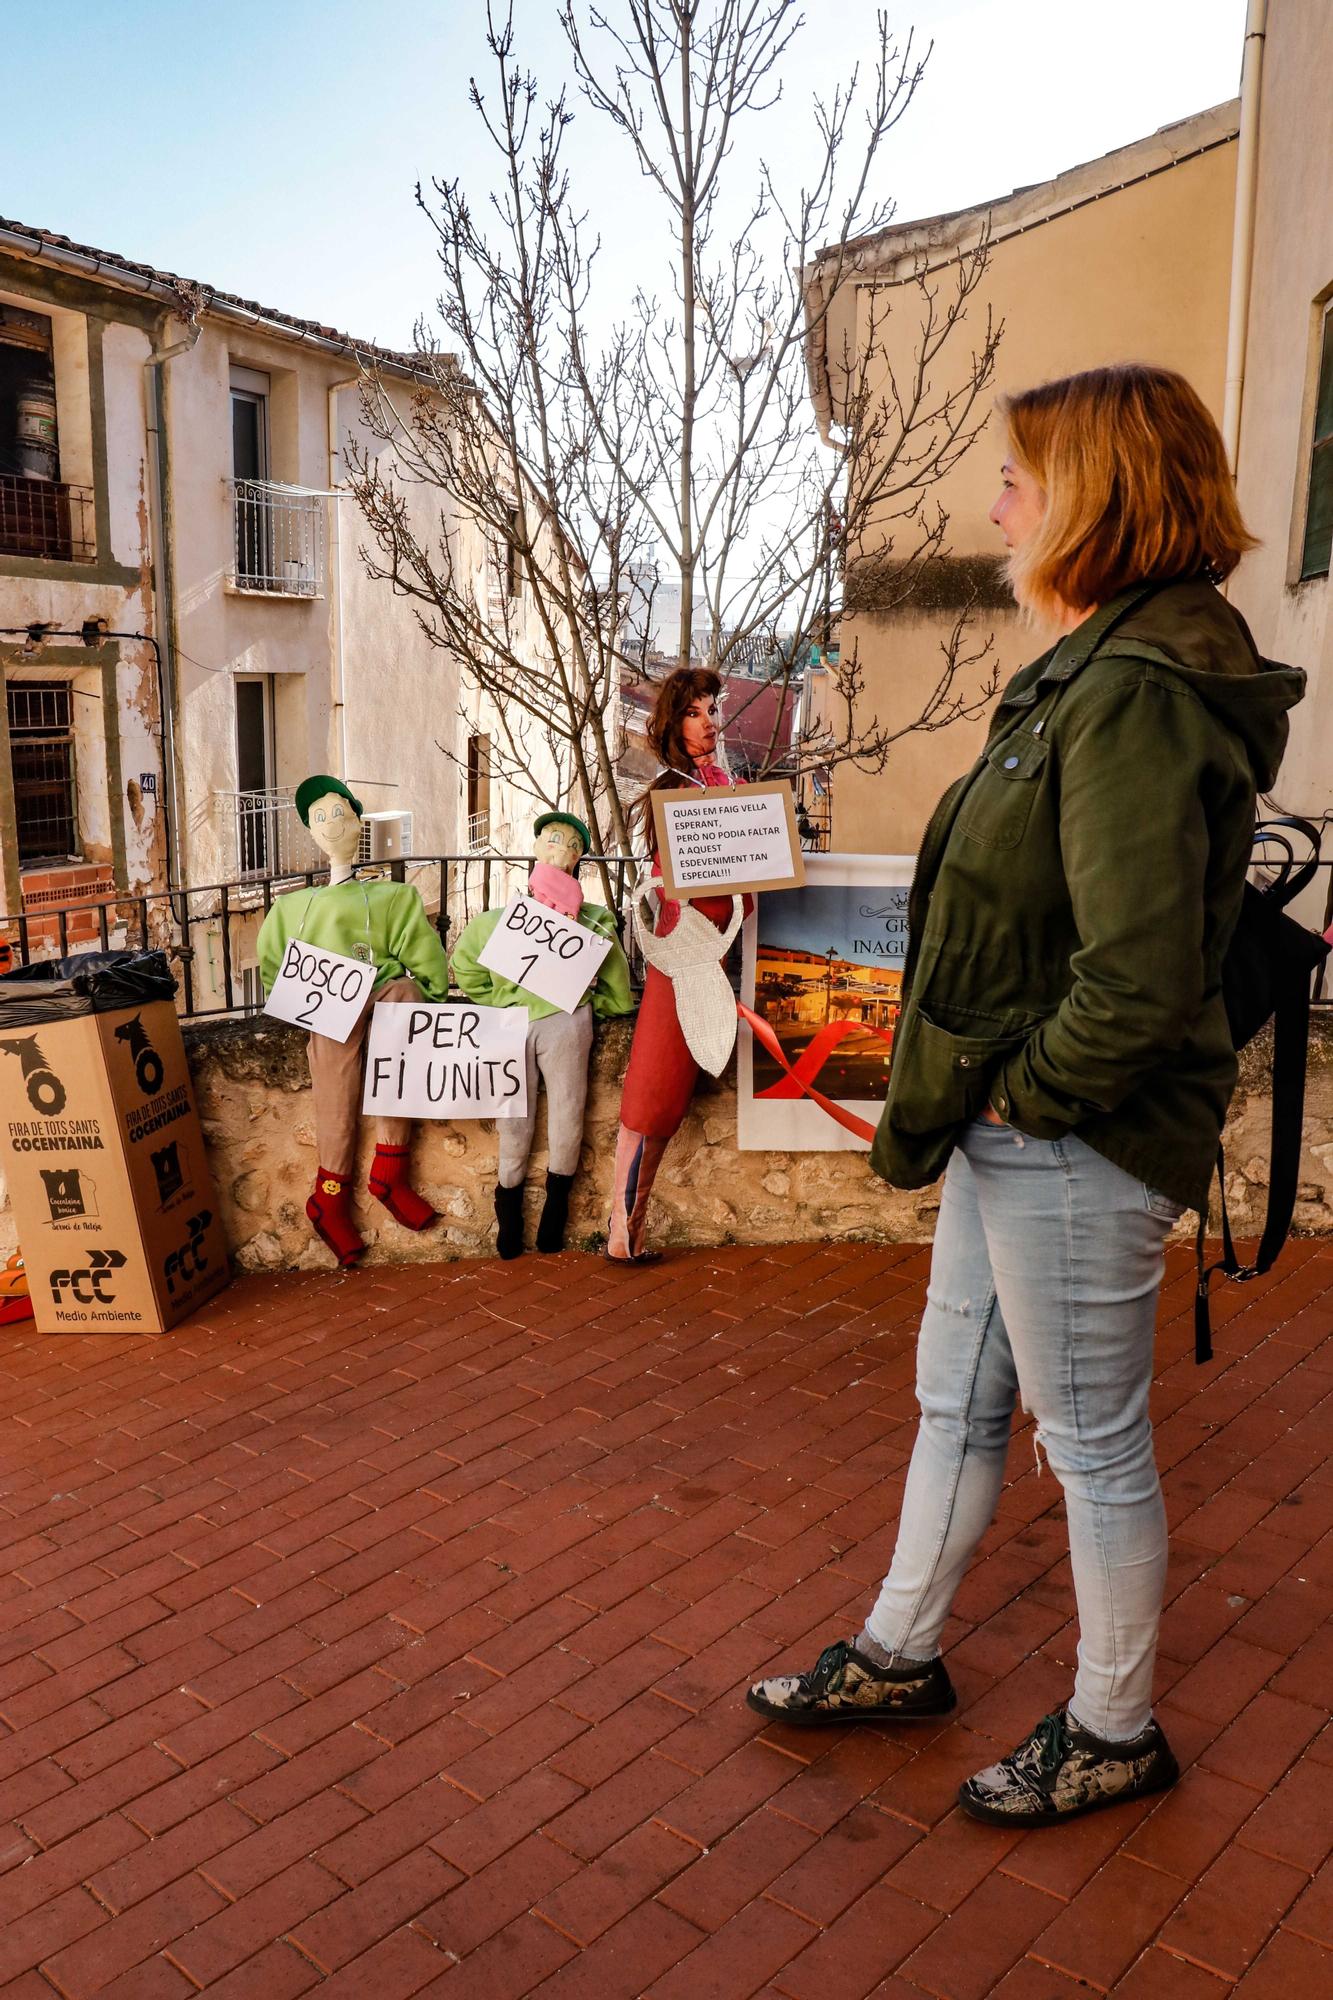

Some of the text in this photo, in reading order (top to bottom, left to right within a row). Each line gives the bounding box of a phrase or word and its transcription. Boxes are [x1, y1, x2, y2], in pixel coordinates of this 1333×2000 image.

[142, 776, 155, 790] 40
[673, 803, 768, 818] QUASI EM FAIG VELLA
[675, 820, 722, 830] ESPERANT,
[676, 827, 780, 842] PERÒ NO PODIA FALTAR
[687, 844, 722, 854] AQUEST
[680, 853, 768, 868] ESDEVENIMENT TAN
[682, 869, 731, 881] ESPECIAL!!!
[506, 902, 584, 959] BOSCO
[283, 945, 363, 1002] BOSCO
[517, 955, 539, 983] 1
[295, 991, 323, 1026] 2
[408, 1010, 480, 1048] PER
[126, 1084, 188, 1129] FIRA DE TOTS SANTS
[8, 1119, 100, 1136] FIRA DE TOTS SANTS
[129, 1100, 191, 1143] COCENTAINA
[12, 1136, 104, 1152] COCENTAINA
[164, 1232, 209, 1295] FCC
[49, 1269, 117, 1304] FCC
[56, 1310, 143, 1321] Medio Ambiente
